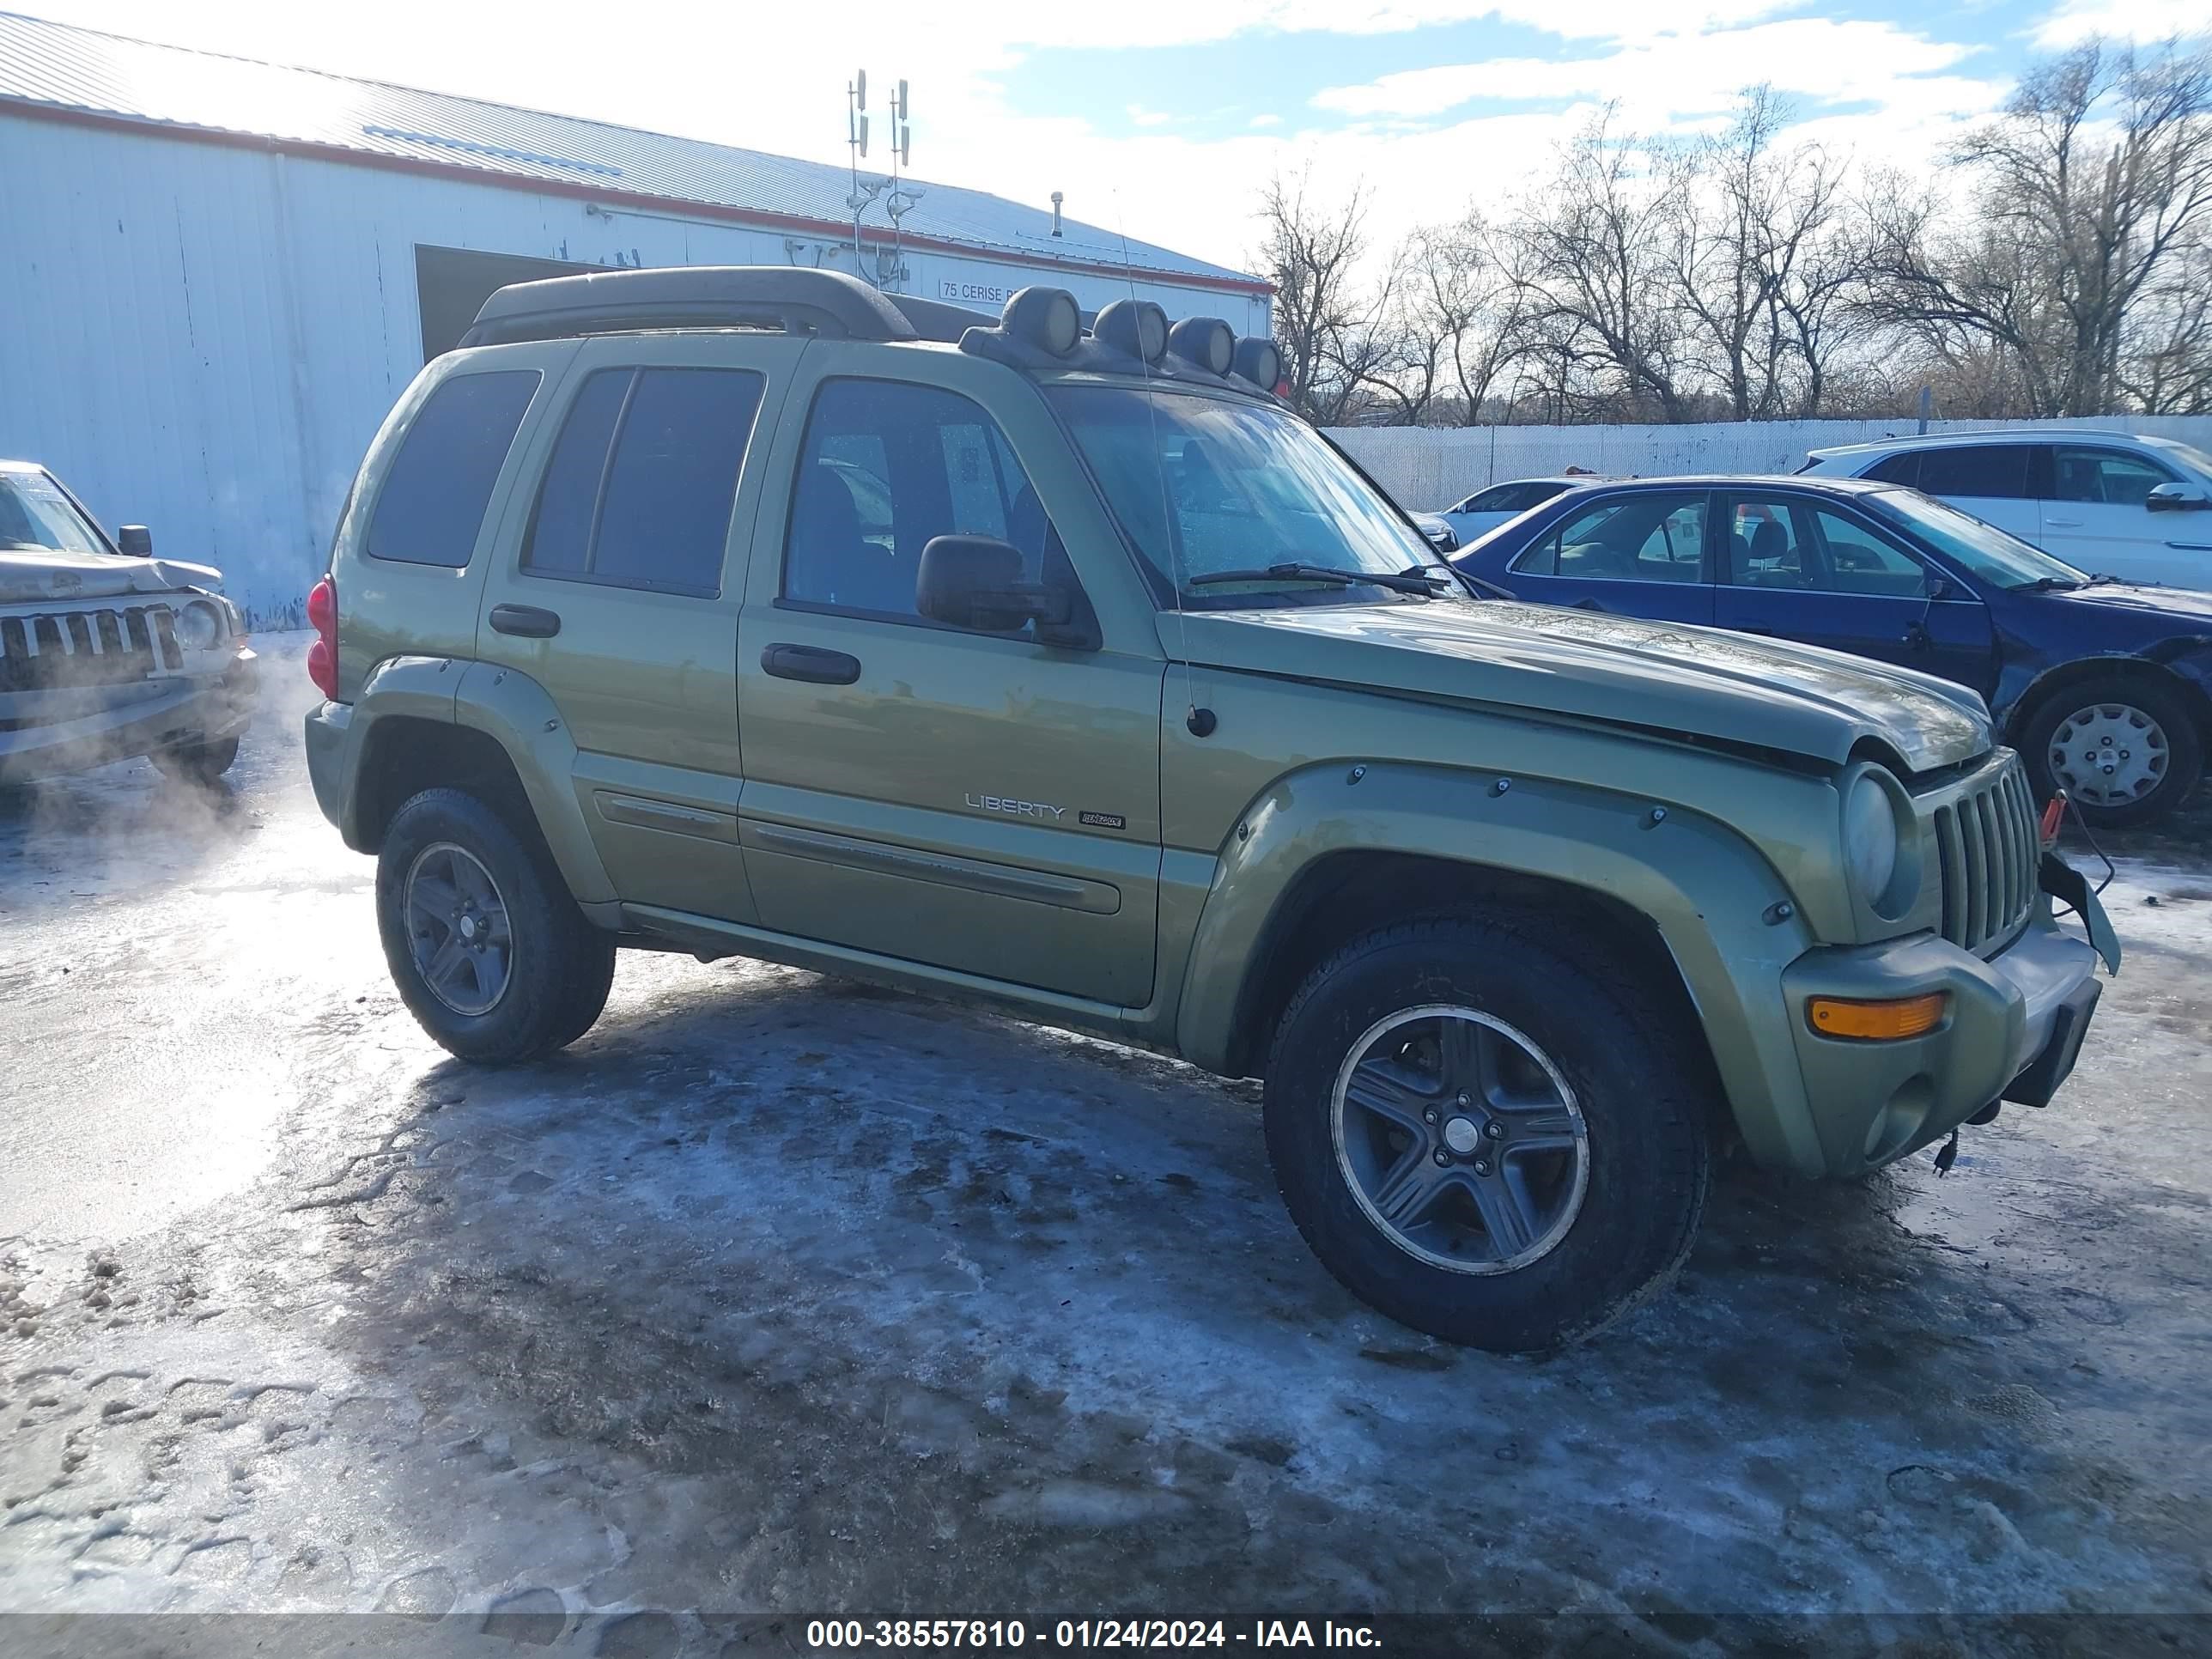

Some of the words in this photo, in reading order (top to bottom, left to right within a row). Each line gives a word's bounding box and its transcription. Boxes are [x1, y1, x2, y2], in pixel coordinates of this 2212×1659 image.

[944, 283, 957, 297] 75
[962, 284, 1002, 301] CERISE
[964, 793, 1067, 821] LIBERTY
[1082, 812, 1121, 827] RENEGADE
